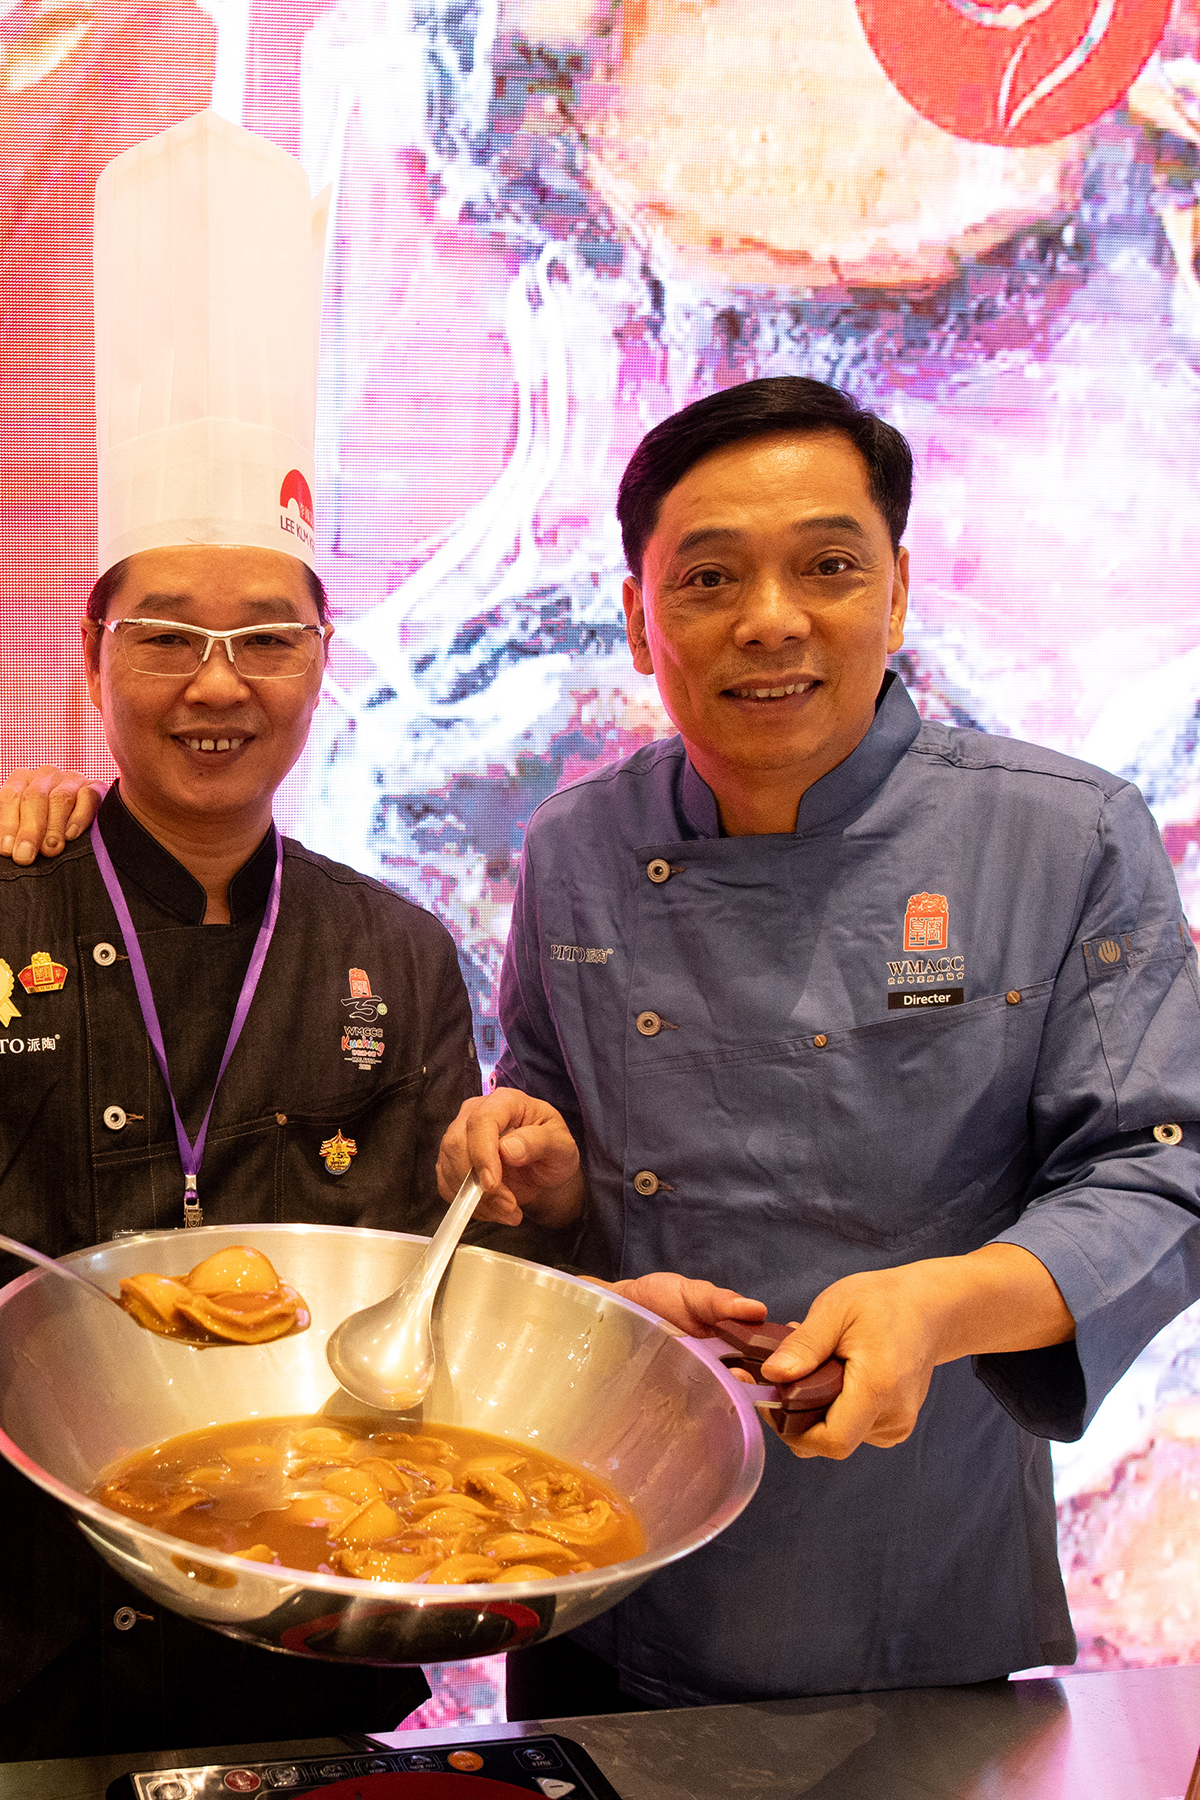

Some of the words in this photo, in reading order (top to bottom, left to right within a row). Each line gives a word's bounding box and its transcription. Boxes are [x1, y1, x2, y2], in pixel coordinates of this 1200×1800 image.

[279, 514, 295, 536] LEE
[550, 944, 585, 963] PITO
[886, 956, 964, 976] WMACC
[903, 993, 951, 1006] Directer
[341, 1035, 385, 1057] Kuching
